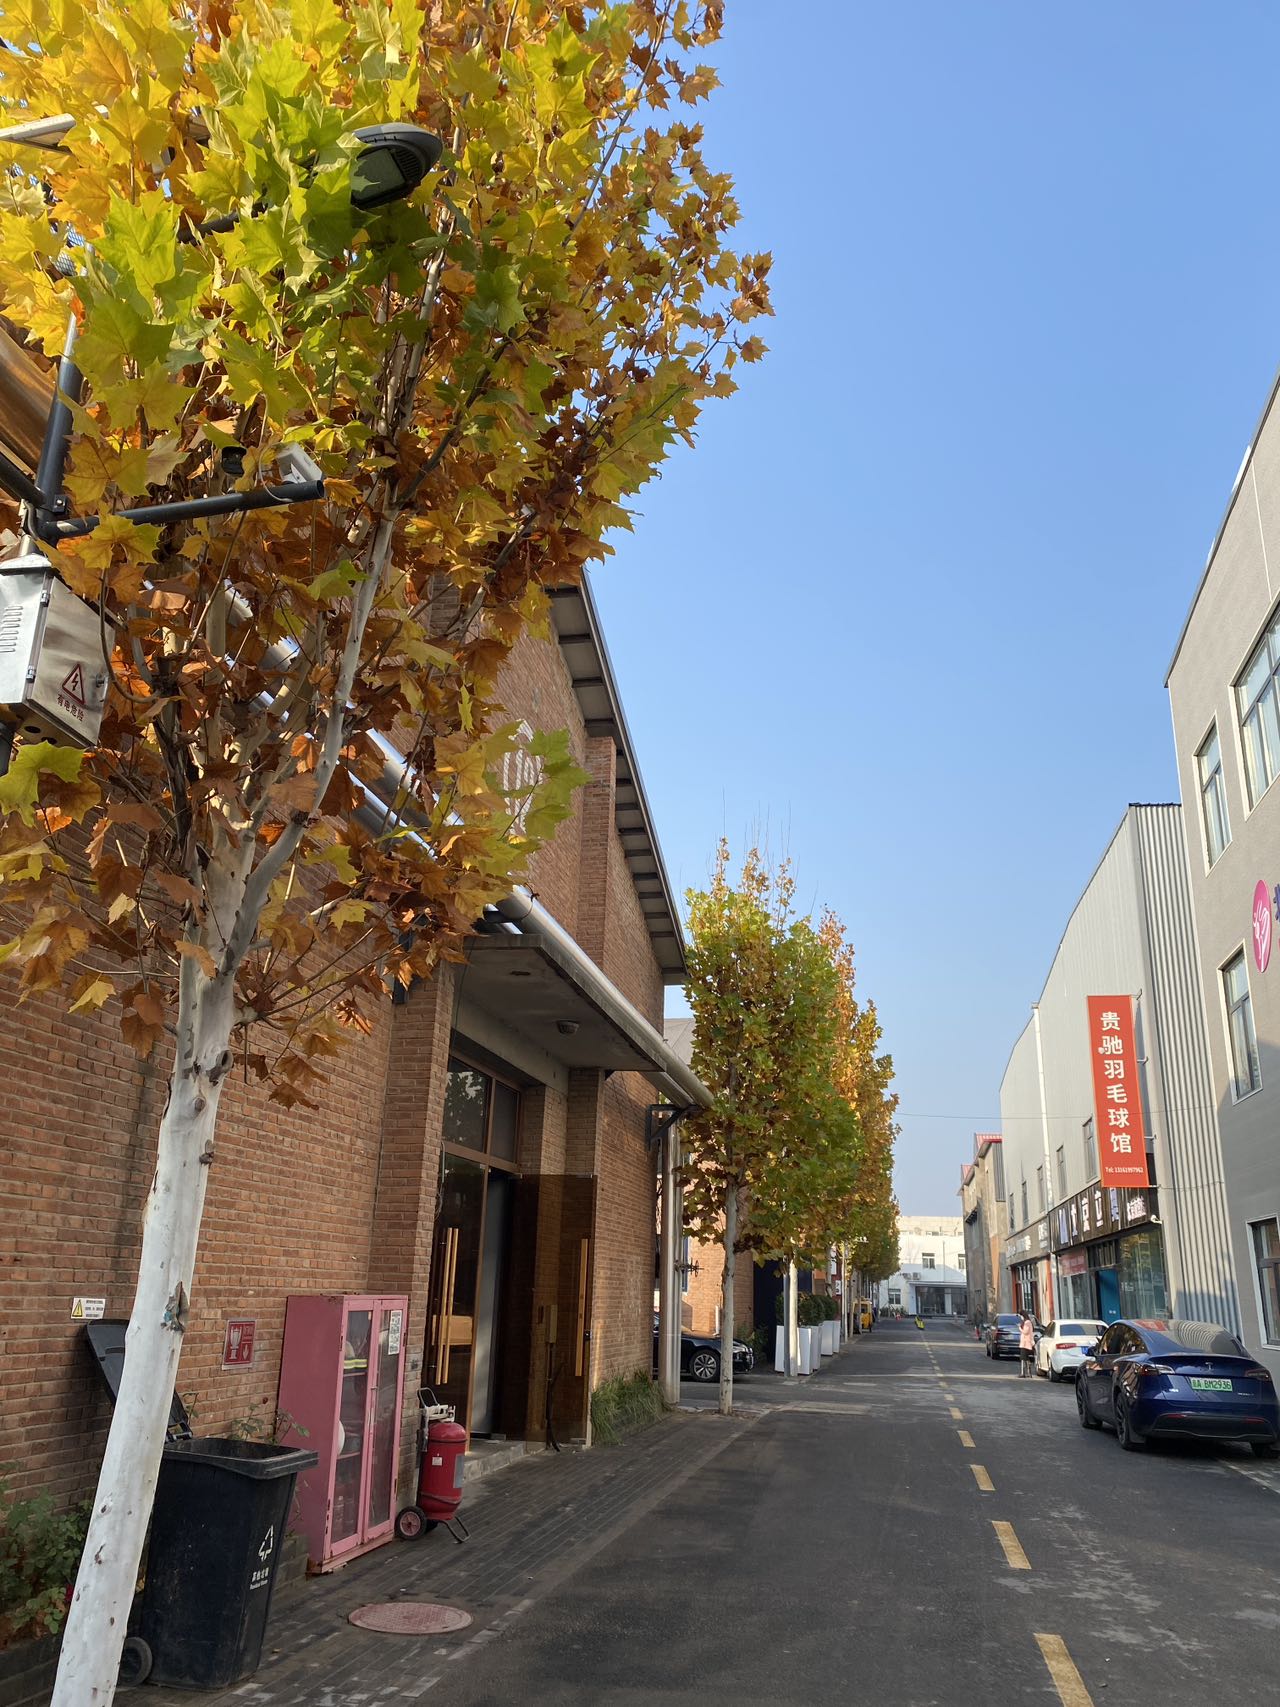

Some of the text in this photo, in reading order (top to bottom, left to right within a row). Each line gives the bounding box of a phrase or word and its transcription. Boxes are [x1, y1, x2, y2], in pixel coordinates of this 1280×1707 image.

[57, 693, 84, 722] 有电危险
[1100, 1011, 1132, 1154] 贵驰羽毛球馆
